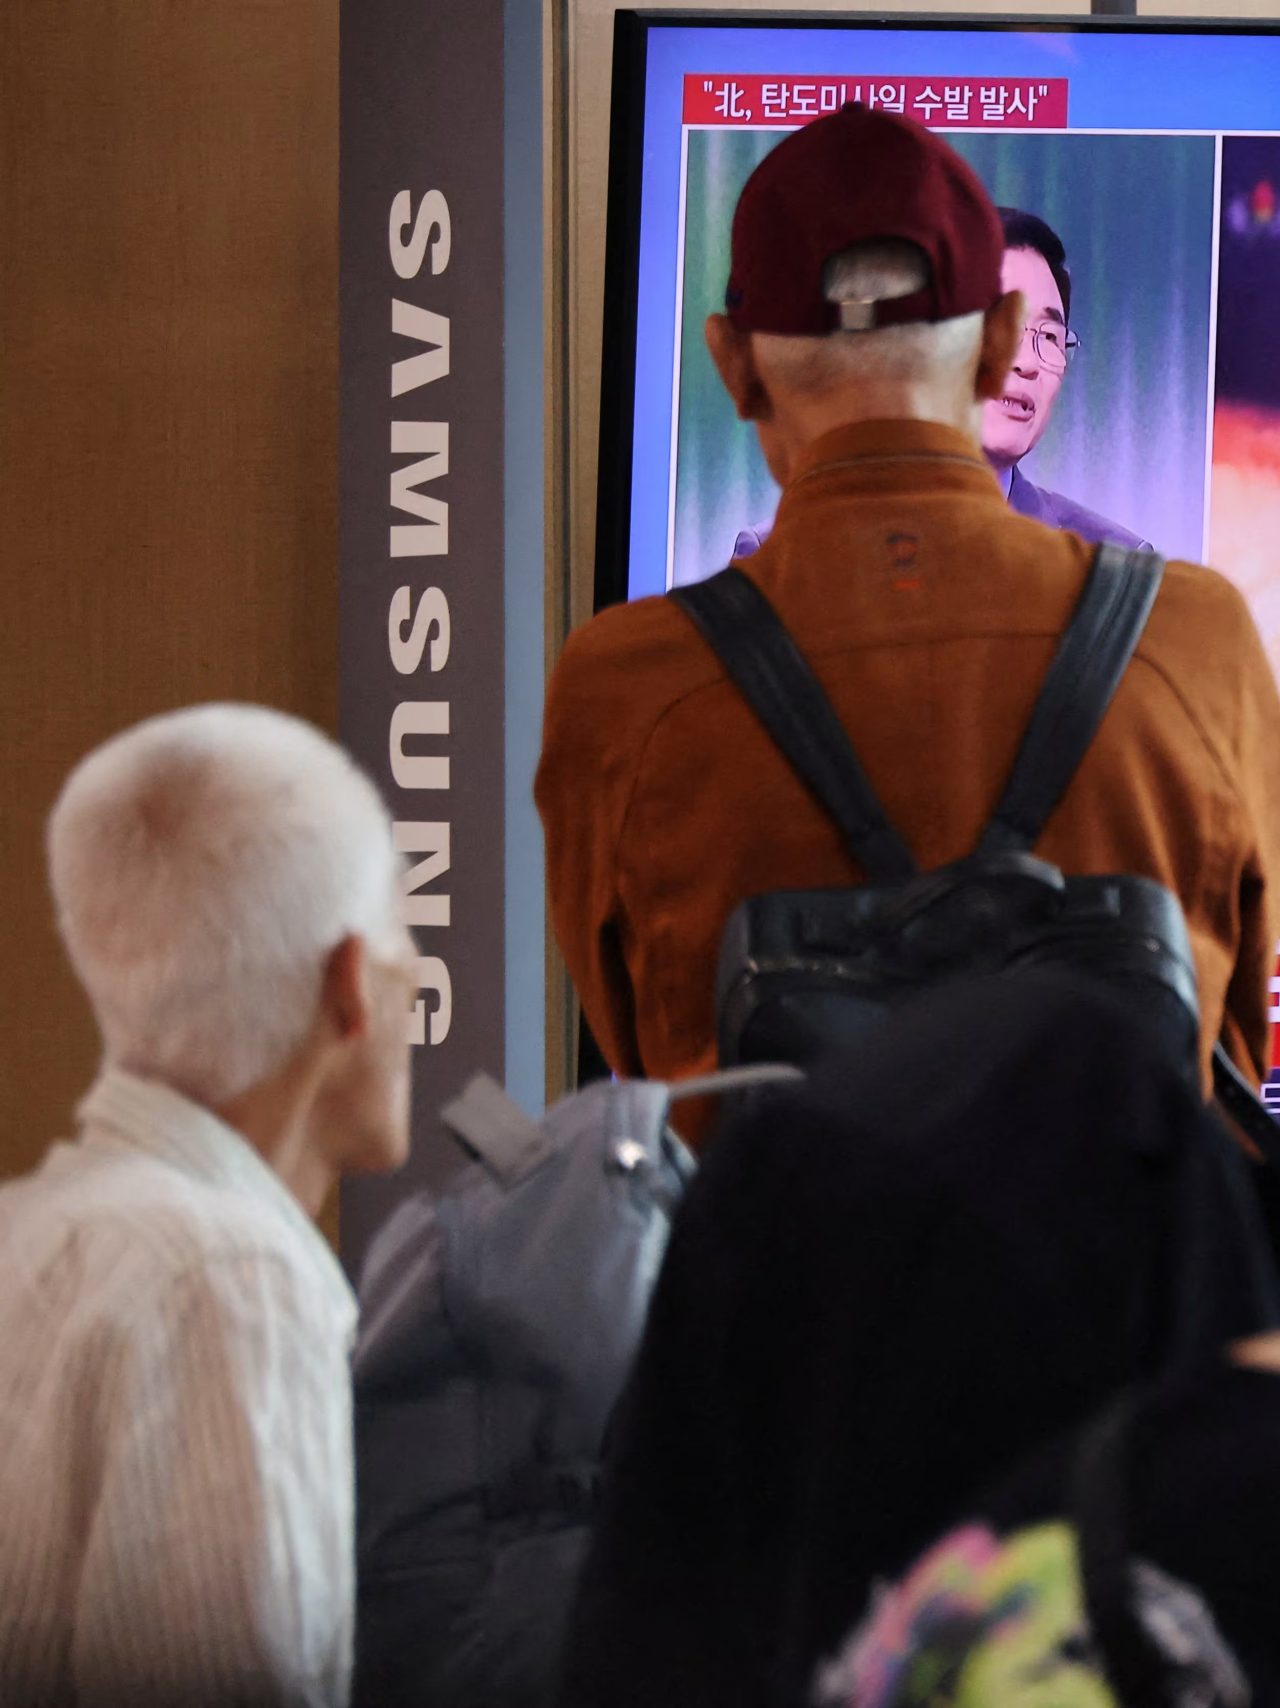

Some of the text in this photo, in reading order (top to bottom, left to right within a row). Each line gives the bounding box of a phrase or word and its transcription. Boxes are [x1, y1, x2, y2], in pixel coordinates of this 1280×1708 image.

[703, 81, 752, 121] "北,
[913, 84, 974, 120] 수발
[979, 83, 1049, 121] 발사"
[389, 189, 452, 1045] SAMSUNG
